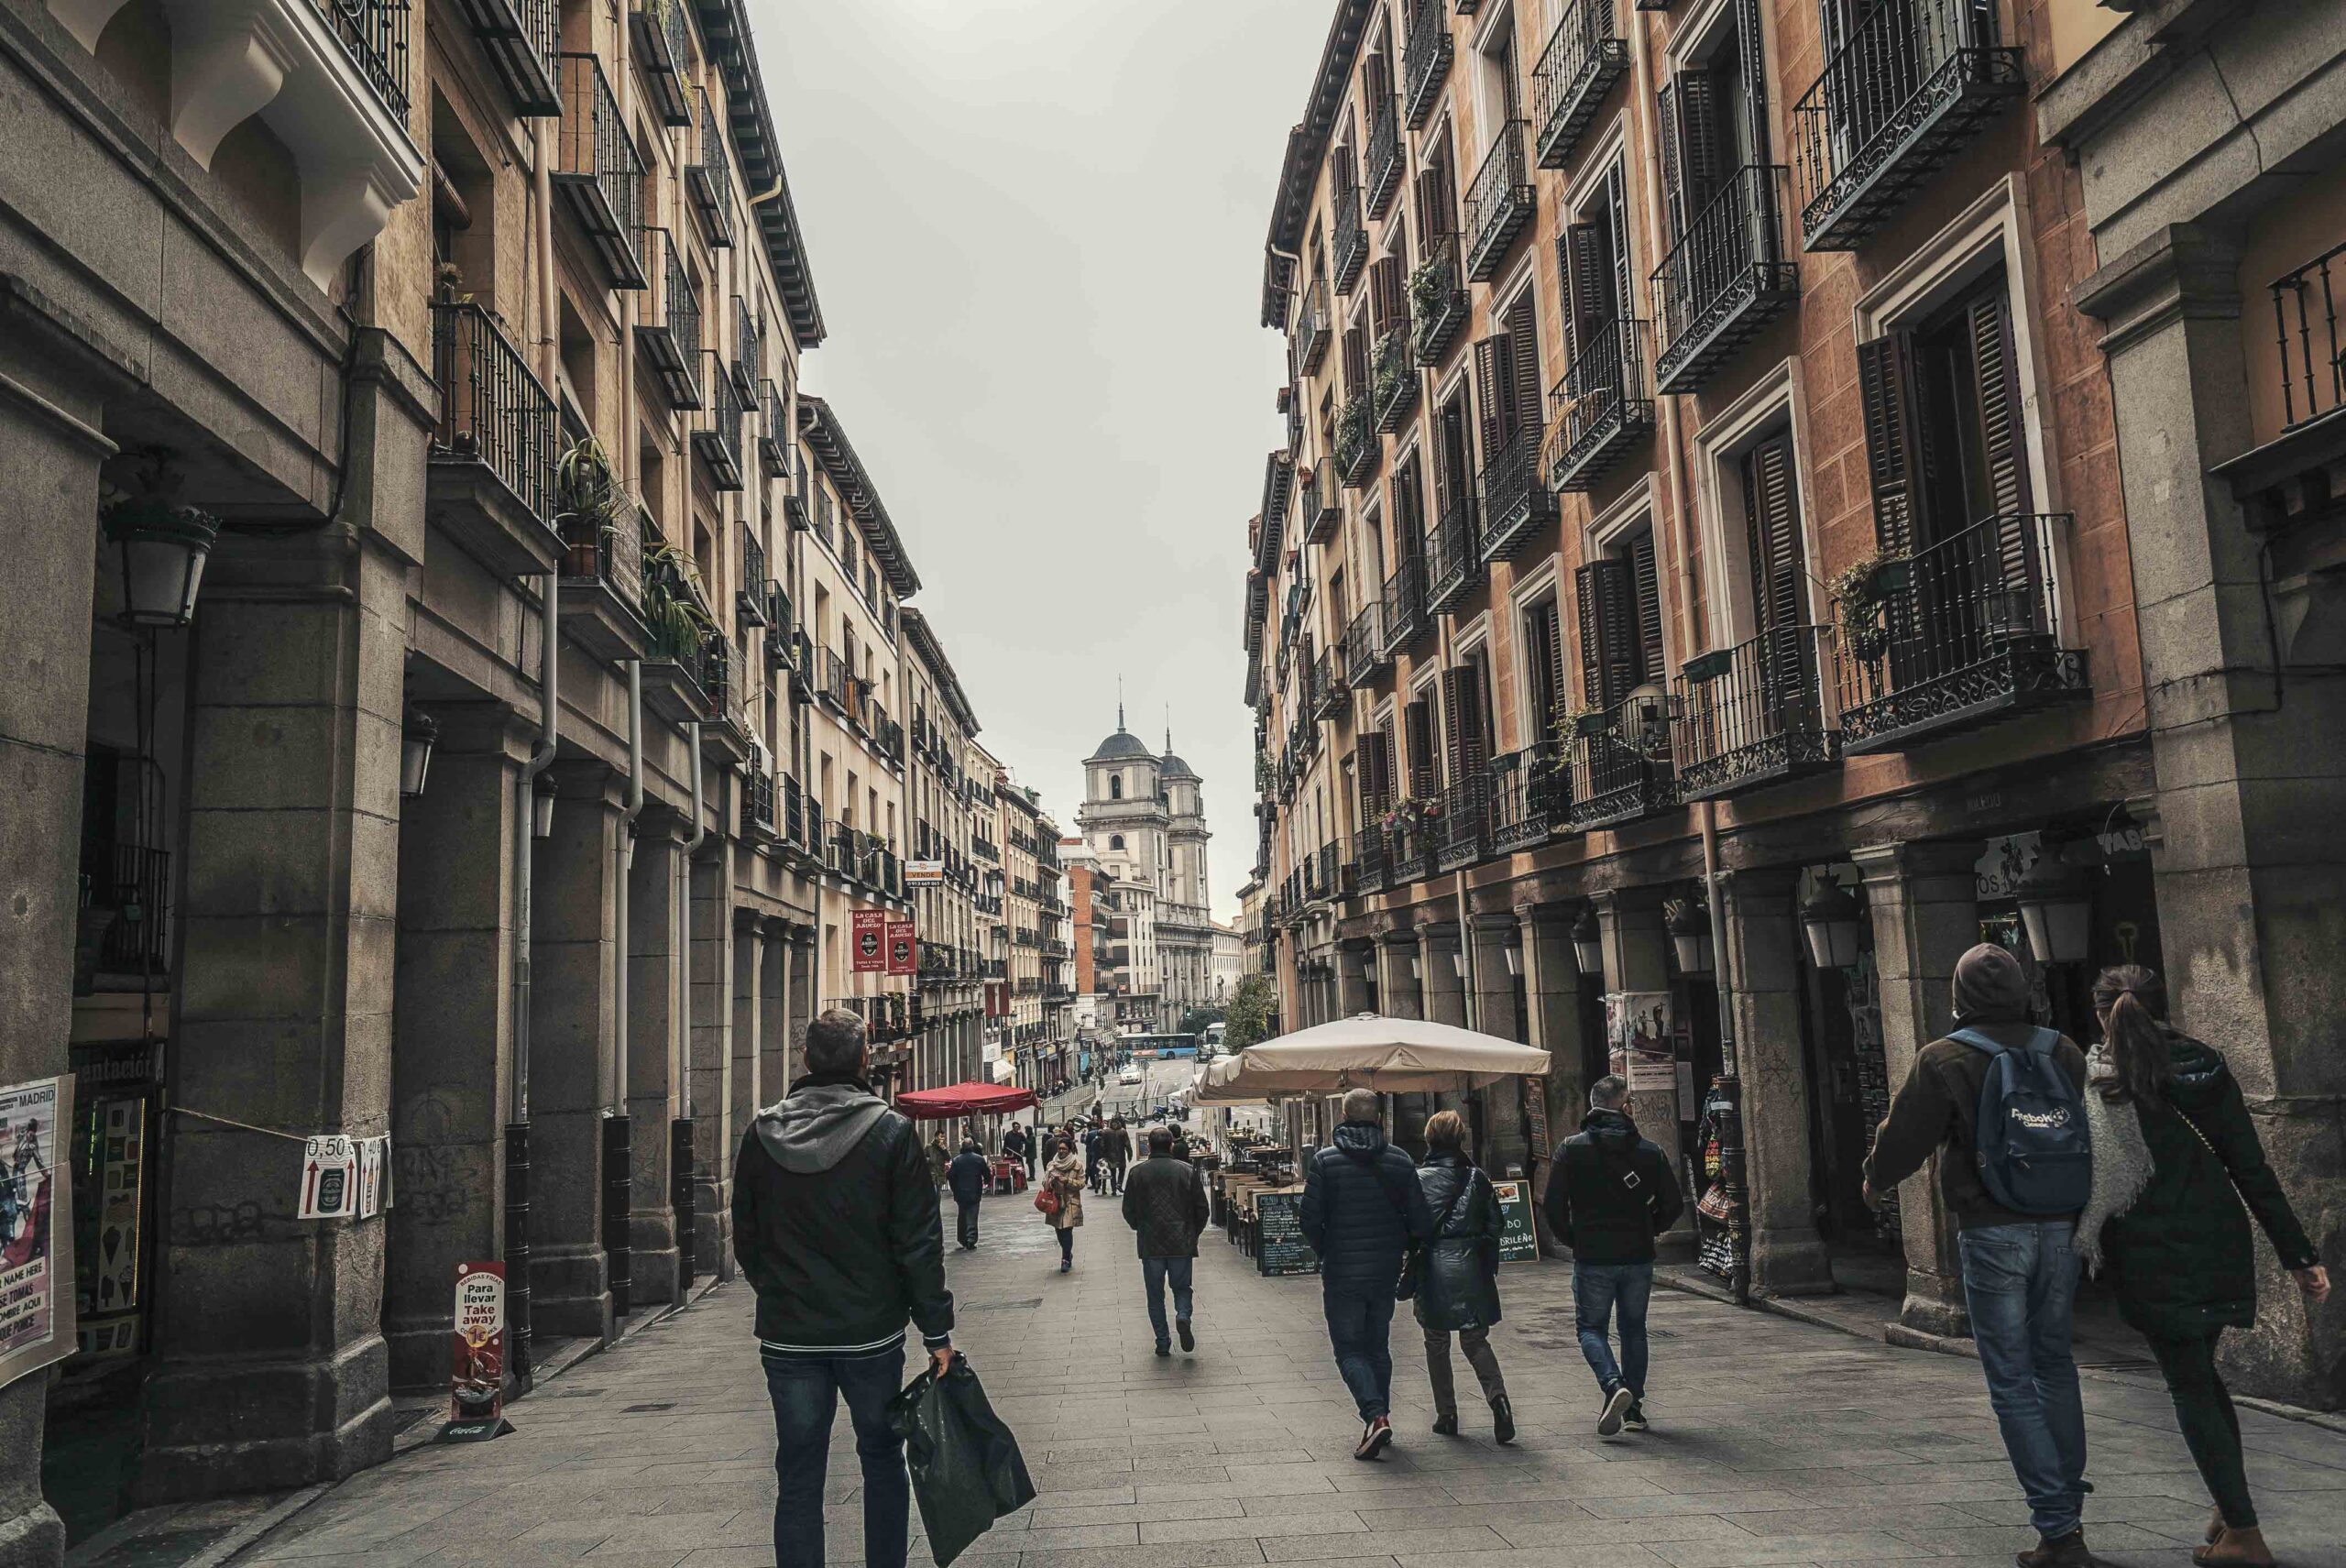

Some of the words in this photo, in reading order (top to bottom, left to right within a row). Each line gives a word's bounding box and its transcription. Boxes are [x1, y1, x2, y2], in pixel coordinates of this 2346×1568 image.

[2096, 829, 2143, 856] TAB
[1979, 874, 2000, 894] OS
[82, 1051, 152, 1082] entación
[19, 1090, 54, 1108] MADRID
[307, 1138, 345, 1158] 0,50
[1507, 1219, 1521, 1229] DO
[1499, 1233, 1533, 1246] DRILEÑO
[4, 1270, 24, 1287] NAME
[26, 1263, 42, 1278] HERE
[460, 1275, 485, 1287] BEBIDAS
[467, 1285, 493, 1293] Para
[464, 1294, 496, 1303] llevar
[0, 1305, 20, 1322] OMBRE
[23, 1297, 41, 1313] AQUI
[465, 1305, 495, 1315] Take
[463, 1315, 496, 1325] away
